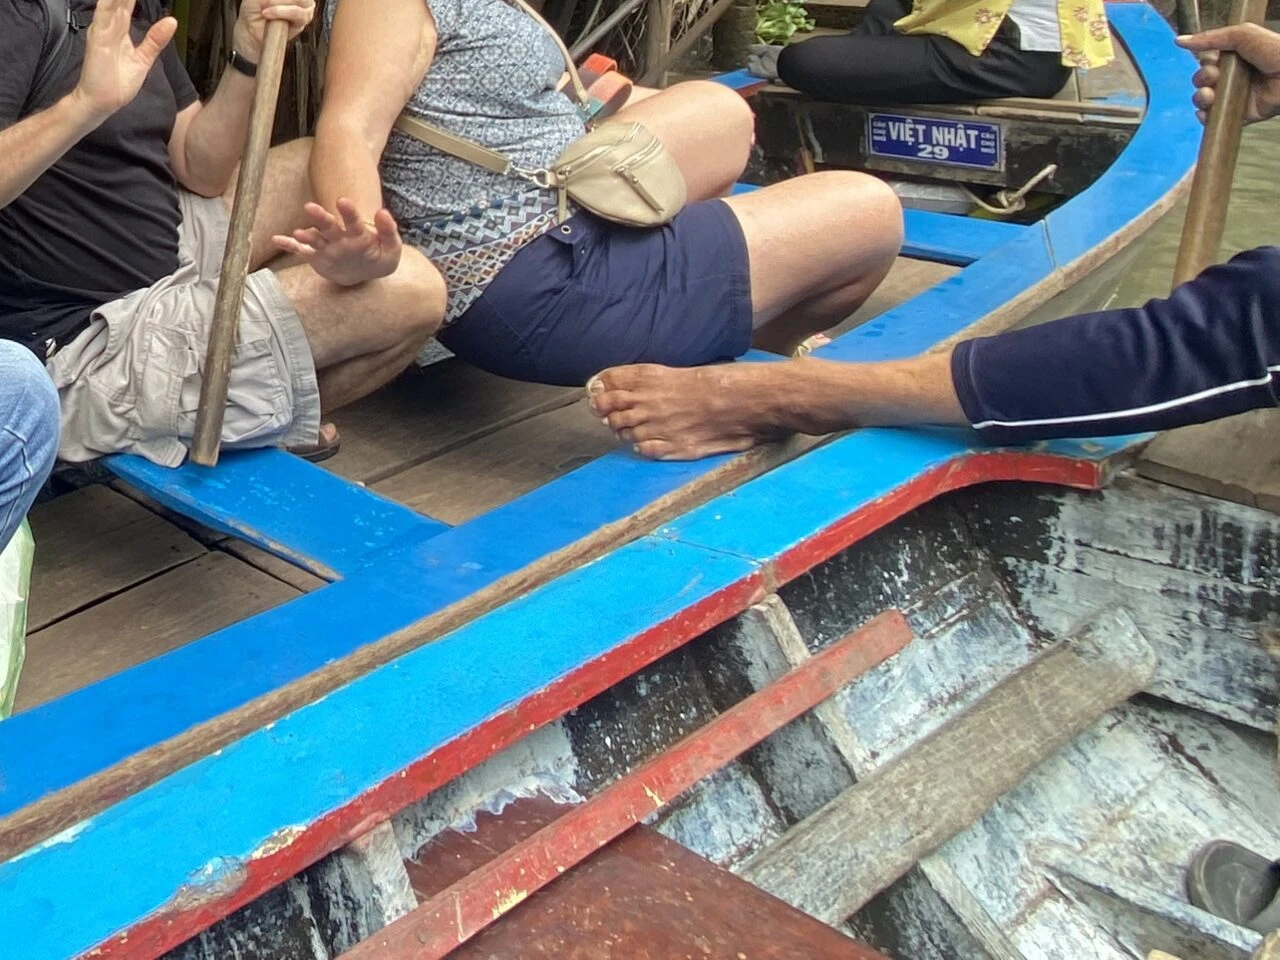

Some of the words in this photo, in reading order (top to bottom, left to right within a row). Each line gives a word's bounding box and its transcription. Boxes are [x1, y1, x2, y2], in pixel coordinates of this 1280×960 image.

[888, 119, 927, 146] VIỆT
[931, 124, 978, 152] NHẬT
[917, 144, 950, 160] 29
